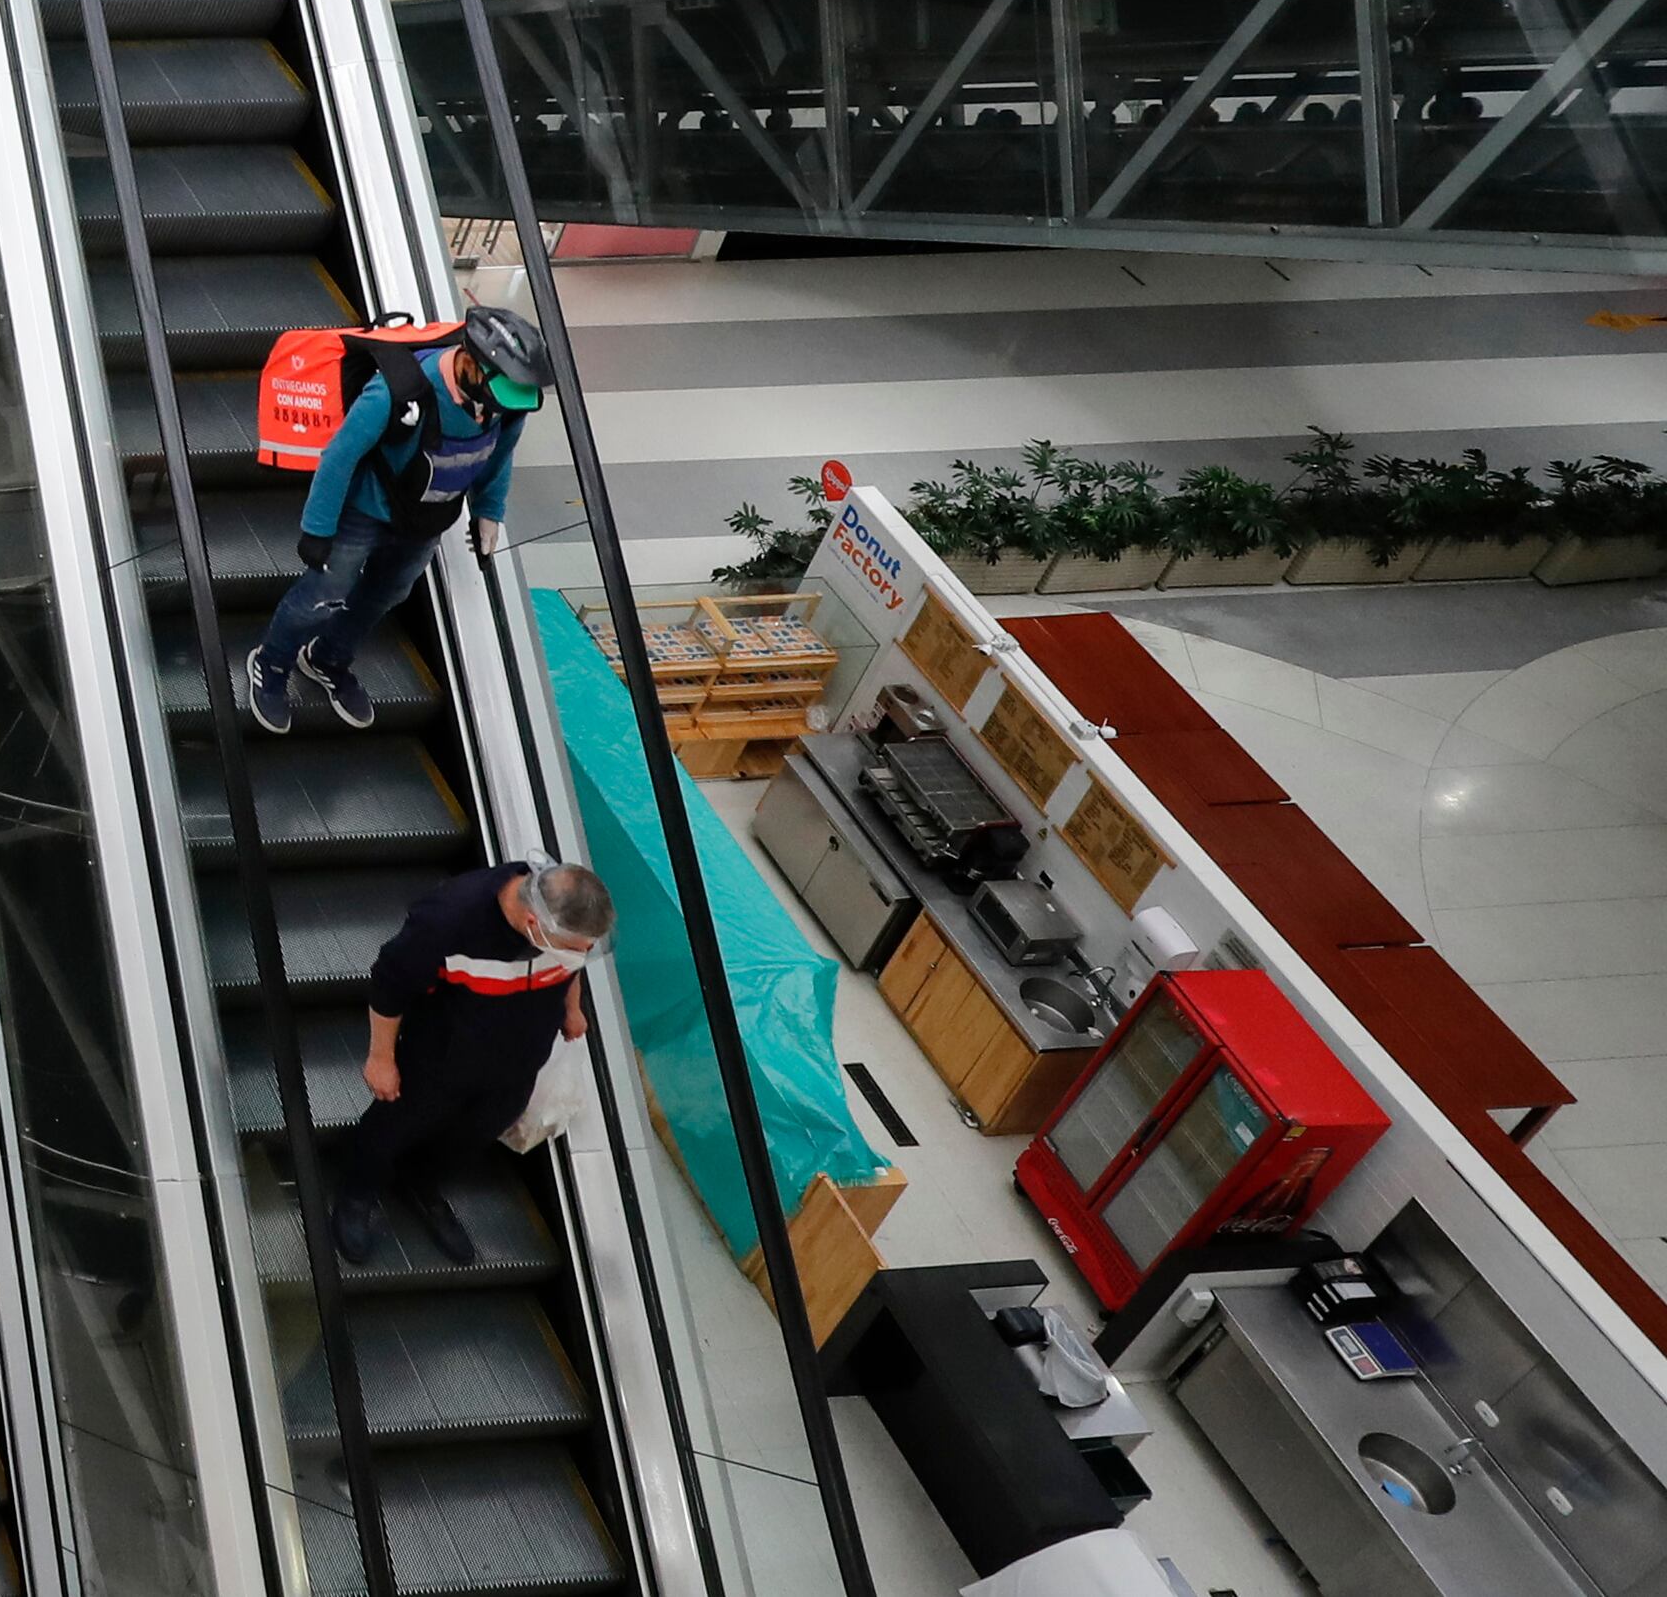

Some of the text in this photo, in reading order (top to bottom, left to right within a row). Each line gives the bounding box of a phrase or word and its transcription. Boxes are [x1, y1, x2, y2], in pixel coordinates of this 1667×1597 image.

[271, 378, 327, 396] ENTREGAMOS
[277, 393, 323, 410] CON AMOR!
[842, 504, 902, 579] Donut
[832, 522, 905, 610] Factory
[1047, 1217, 1079, 1254] Coca-Cola
